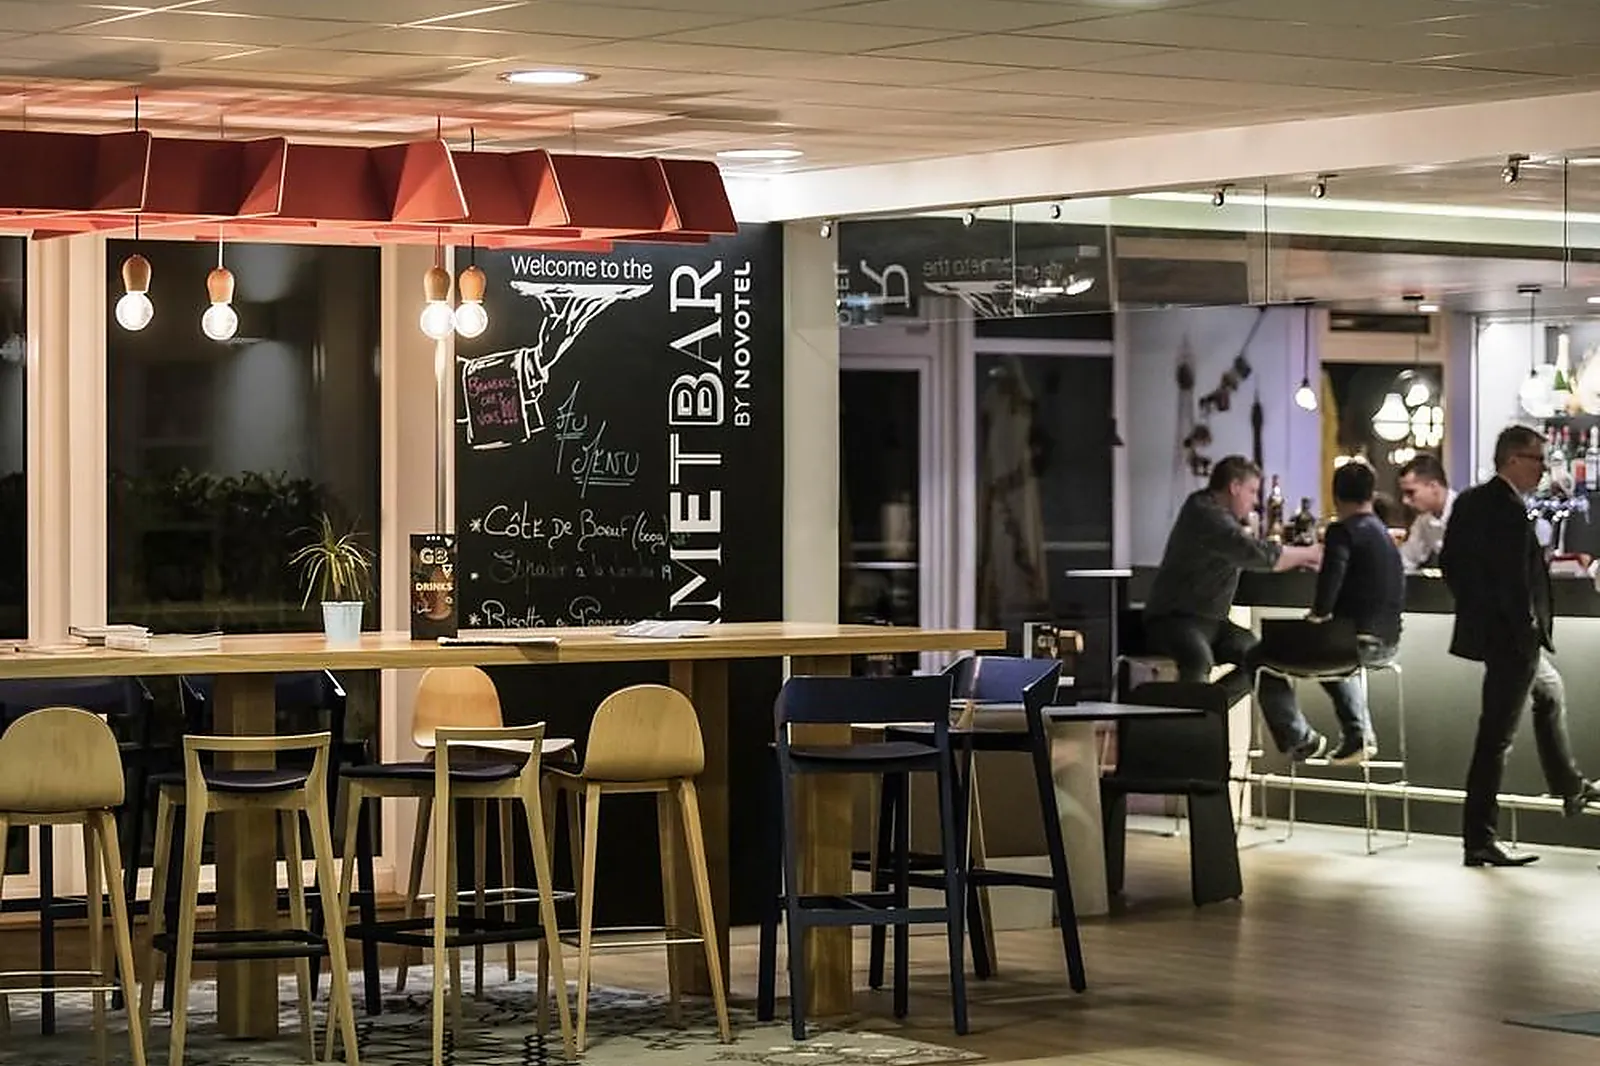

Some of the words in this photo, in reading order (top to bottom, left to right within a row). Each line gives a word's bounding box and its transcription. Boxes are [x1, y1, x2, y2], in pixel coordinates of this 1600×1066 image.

[511, 255, 597, 277] Welcome
[601, 259, 619, 277] to
[622, 256, 652, 279] the
[733, 261, 752, 389] NOVOTEL
[733, 396, 752, 427] BY
[668, 260, 723, 622] METBAR
[415, 582, 454, 592] DRINKS
